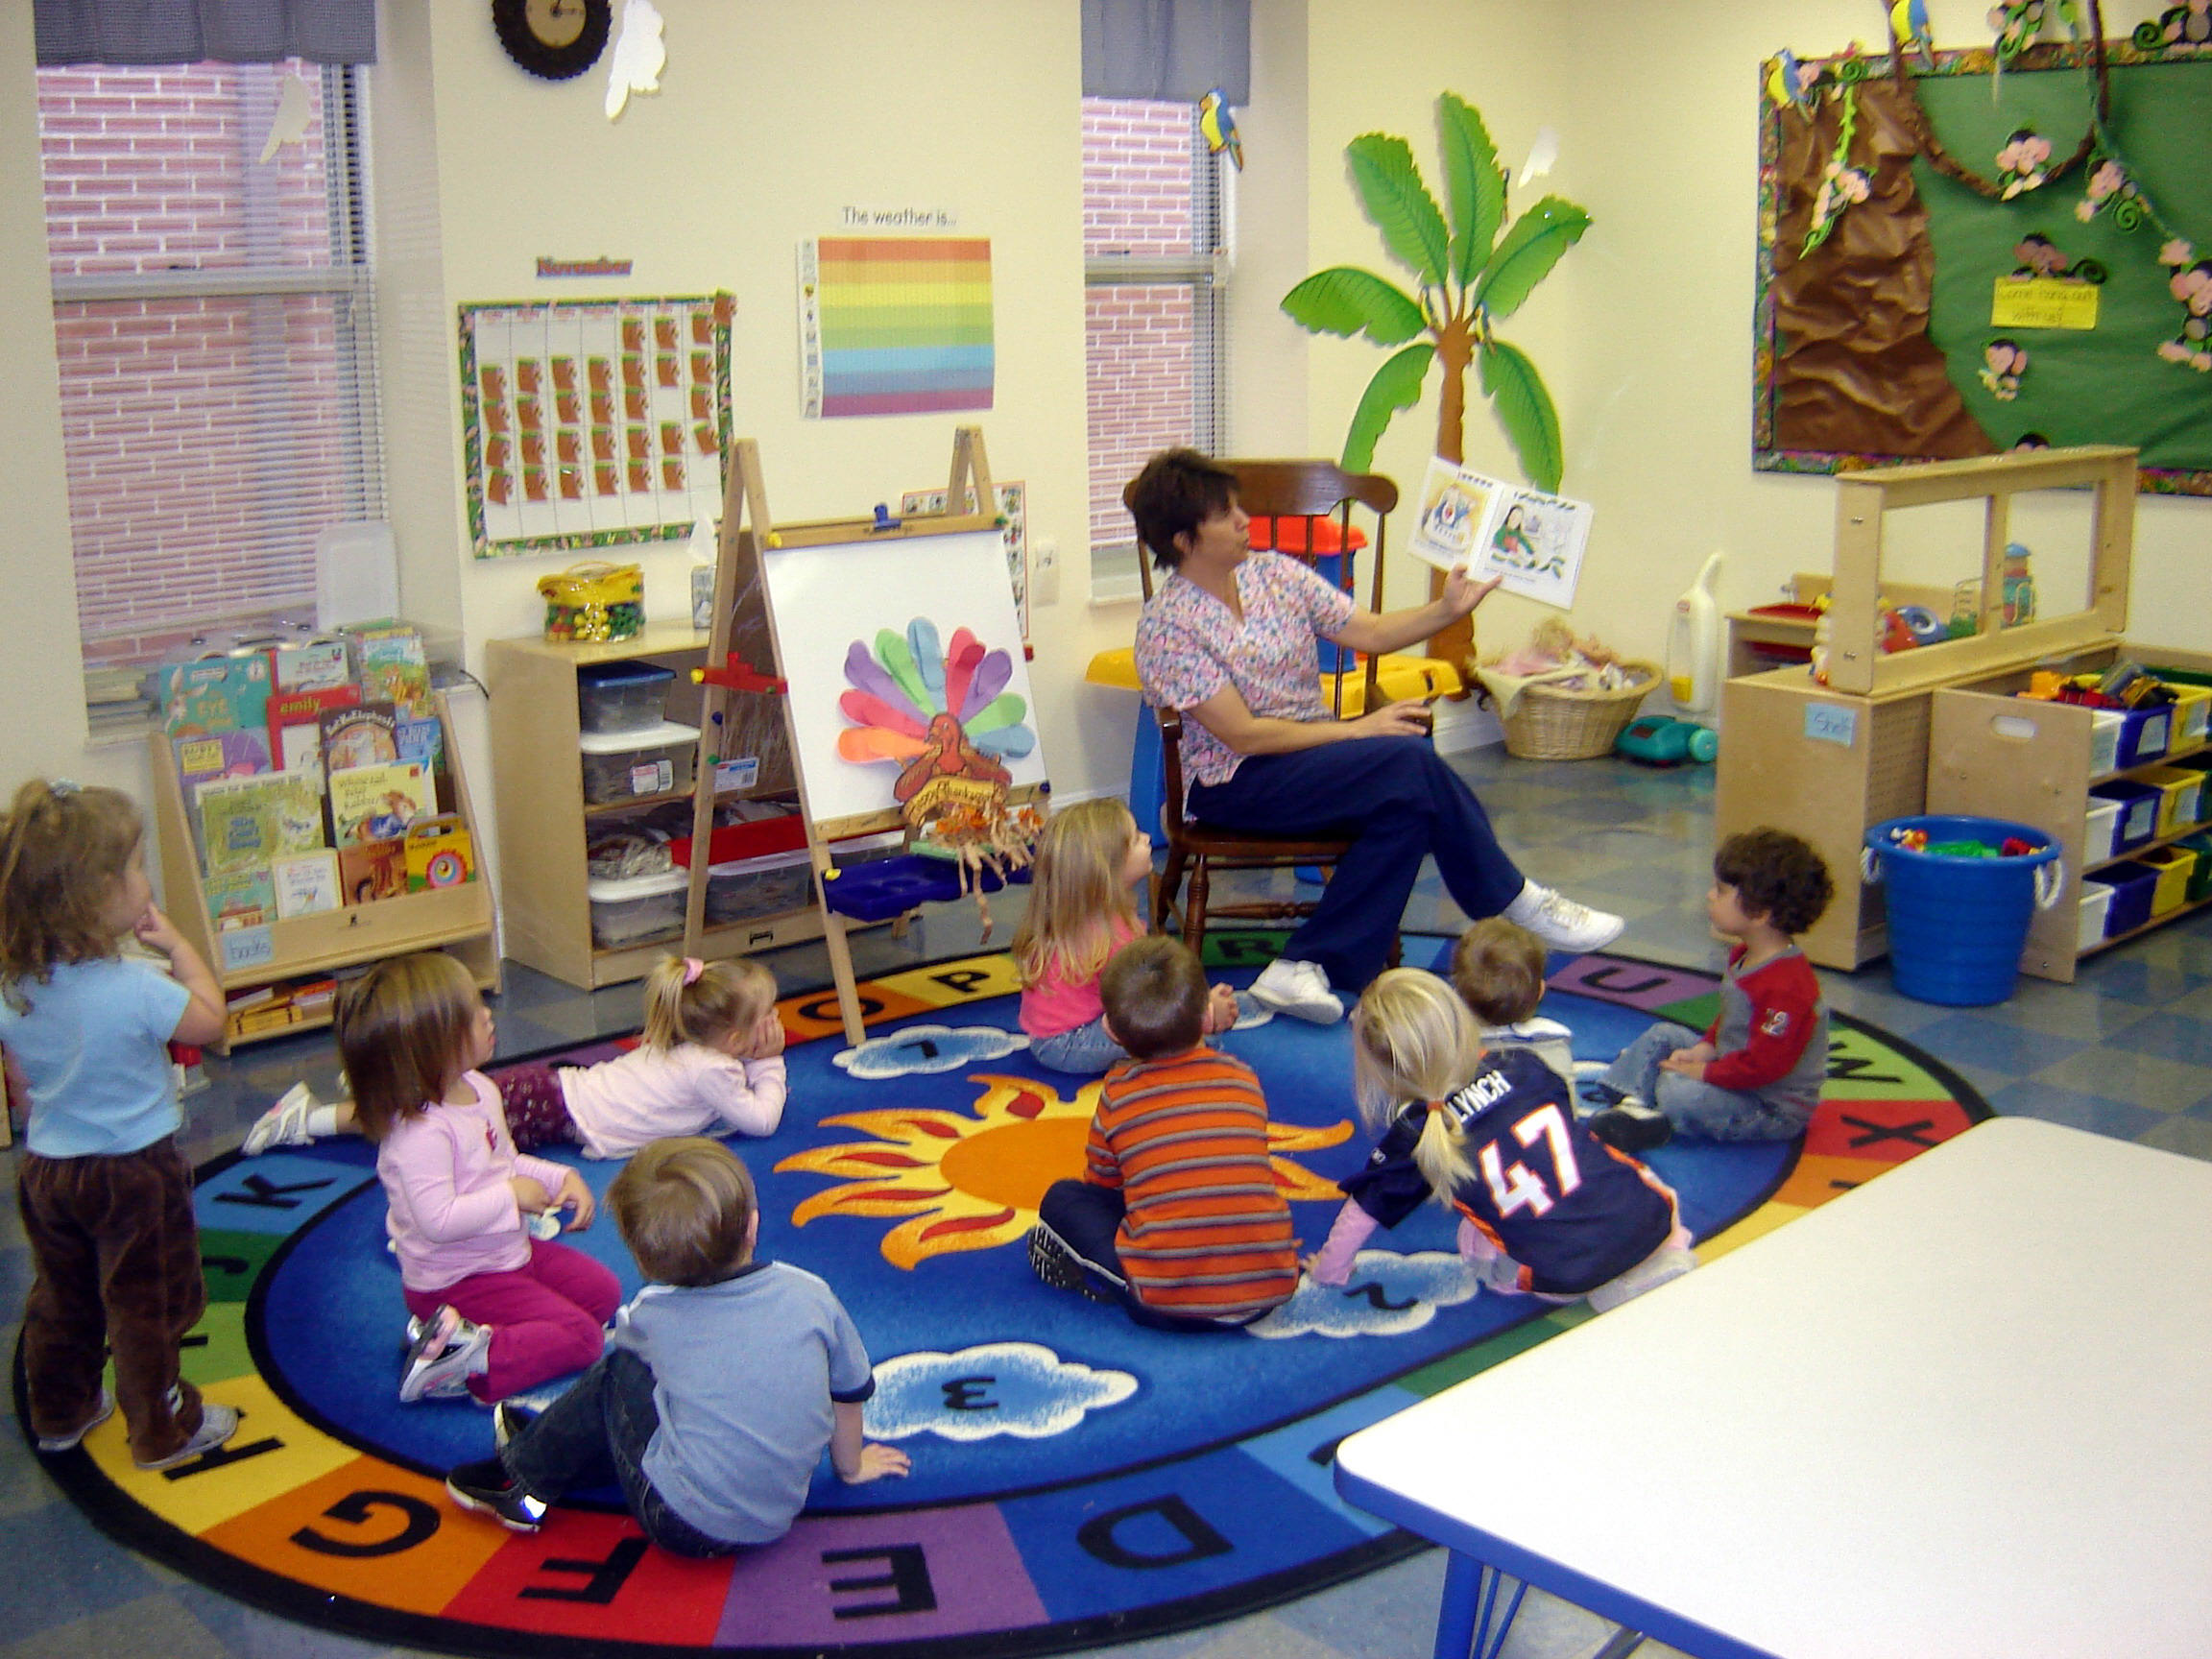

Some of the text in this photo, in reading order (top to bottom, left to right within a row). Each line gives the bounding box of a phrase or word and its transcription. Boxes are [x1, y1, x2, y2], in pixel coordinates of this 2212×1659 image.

[842, 205, 869, 225] The
[874, 206, 934, 227] weather
[536, 255, 634, 277] November
[279, 696, 322, 716] emily
[927, 970, 992, 993] P
[1579, 966, 1671, 994] U
[798, 997, 886, 1022] O
[1446, 1069, 1513, 1124] LYNCH
[1839, 1115, 1941, 1149] X
[1478, 1101, 1582, 1219] 47
[210, 1172, 340, 1210] K
[1342, 1280, 1420, 1310] 2
[941, 1376, 1000, 1411] 3
[289, 1489, 442, 1560] G
[1075, 1493, 1235, 1570] D
[517, 1537, 654, 1605] F
[821, 1542, 938, 1621] E
